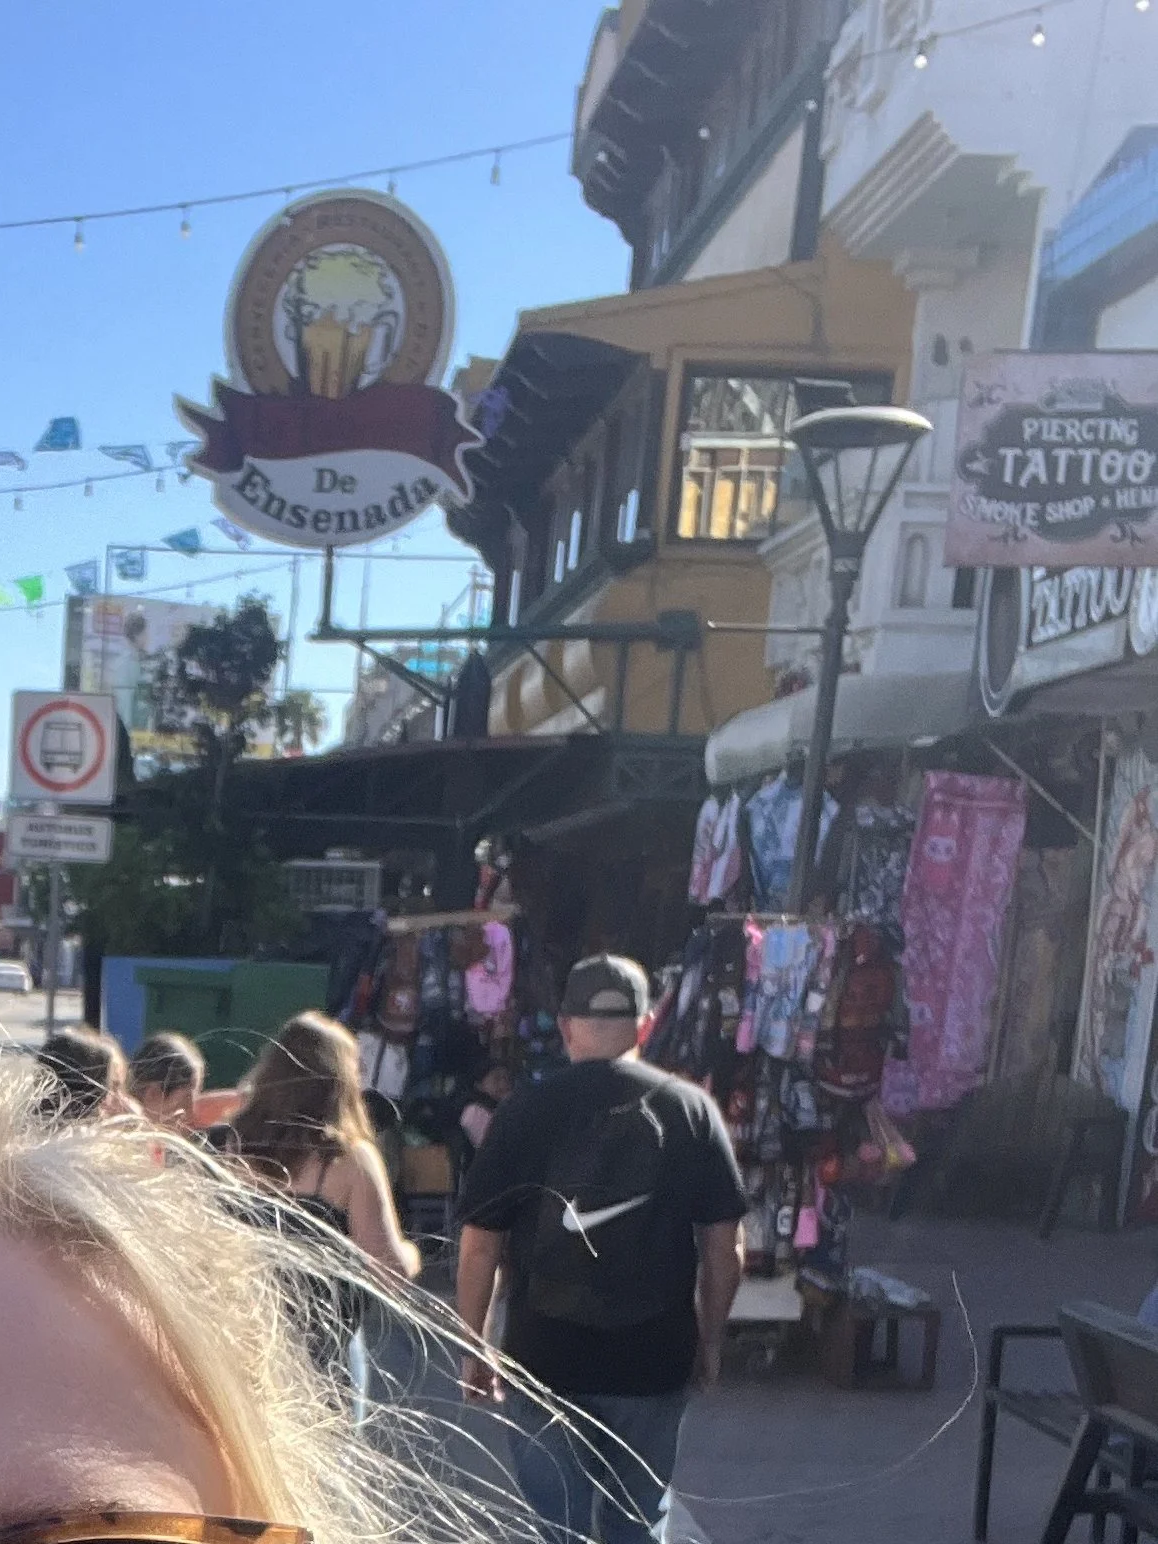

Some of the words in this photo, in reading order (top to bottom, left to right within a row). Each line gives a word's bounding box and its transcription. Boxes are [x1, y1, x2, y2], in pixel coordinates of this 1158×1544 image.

[1022, 418, 1139, 445] PIERCING
[315, 468, 357, 495] De
[999, 448, 1157, 487] TATTOO
[233, 464, 440, 535] Ensenada
[1045, 496, 1096, 524] SHOP
